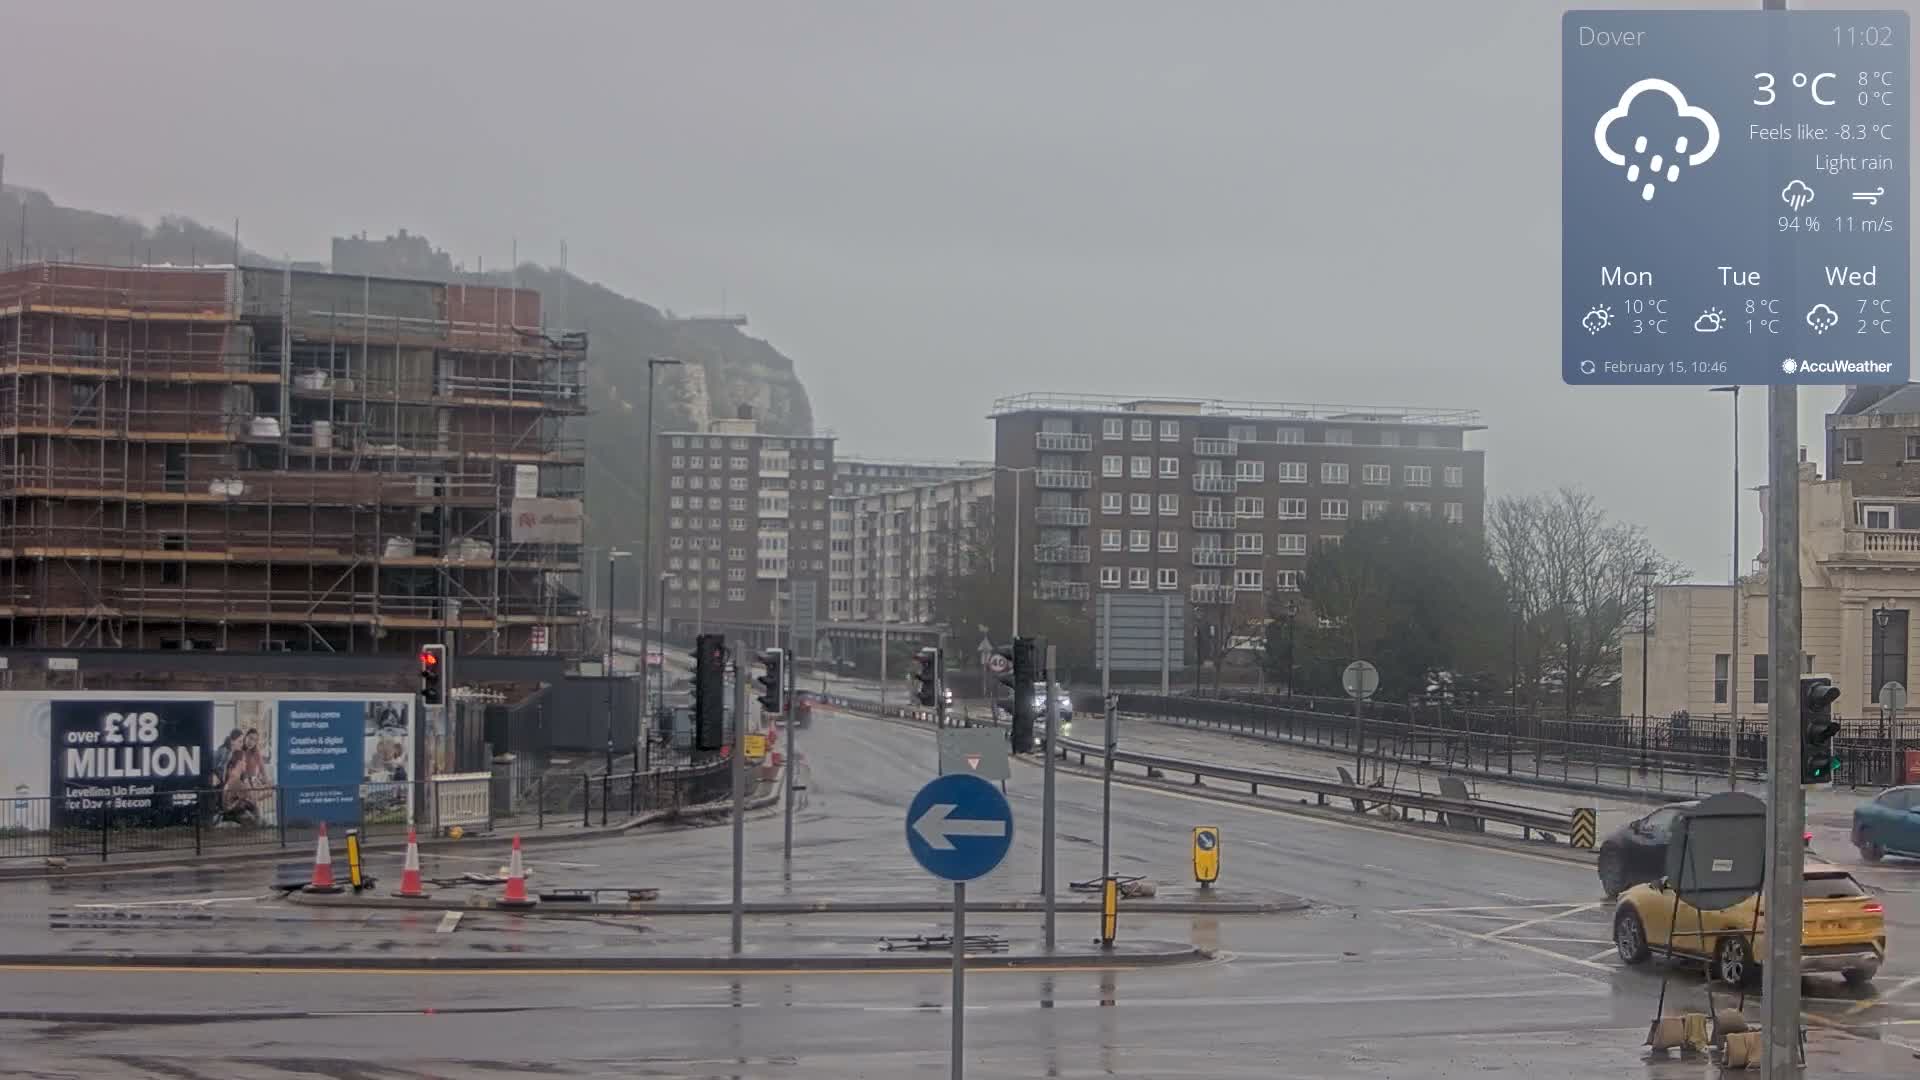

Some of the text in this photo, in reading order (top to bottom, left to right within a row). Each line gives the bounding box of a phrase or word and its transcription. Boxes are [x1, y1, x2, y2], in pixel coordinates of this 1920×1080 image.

[992, 657, 1007, 668] 40
[67, 712, 159, 743] over £18
[290, 736, 317, 745] Creative
[66, 745, 201, 778] MILLION
[129, 784, 155, 796] Fund
[65, 799, 80, 809] for
[82, 798, 112, 809] Dovr
